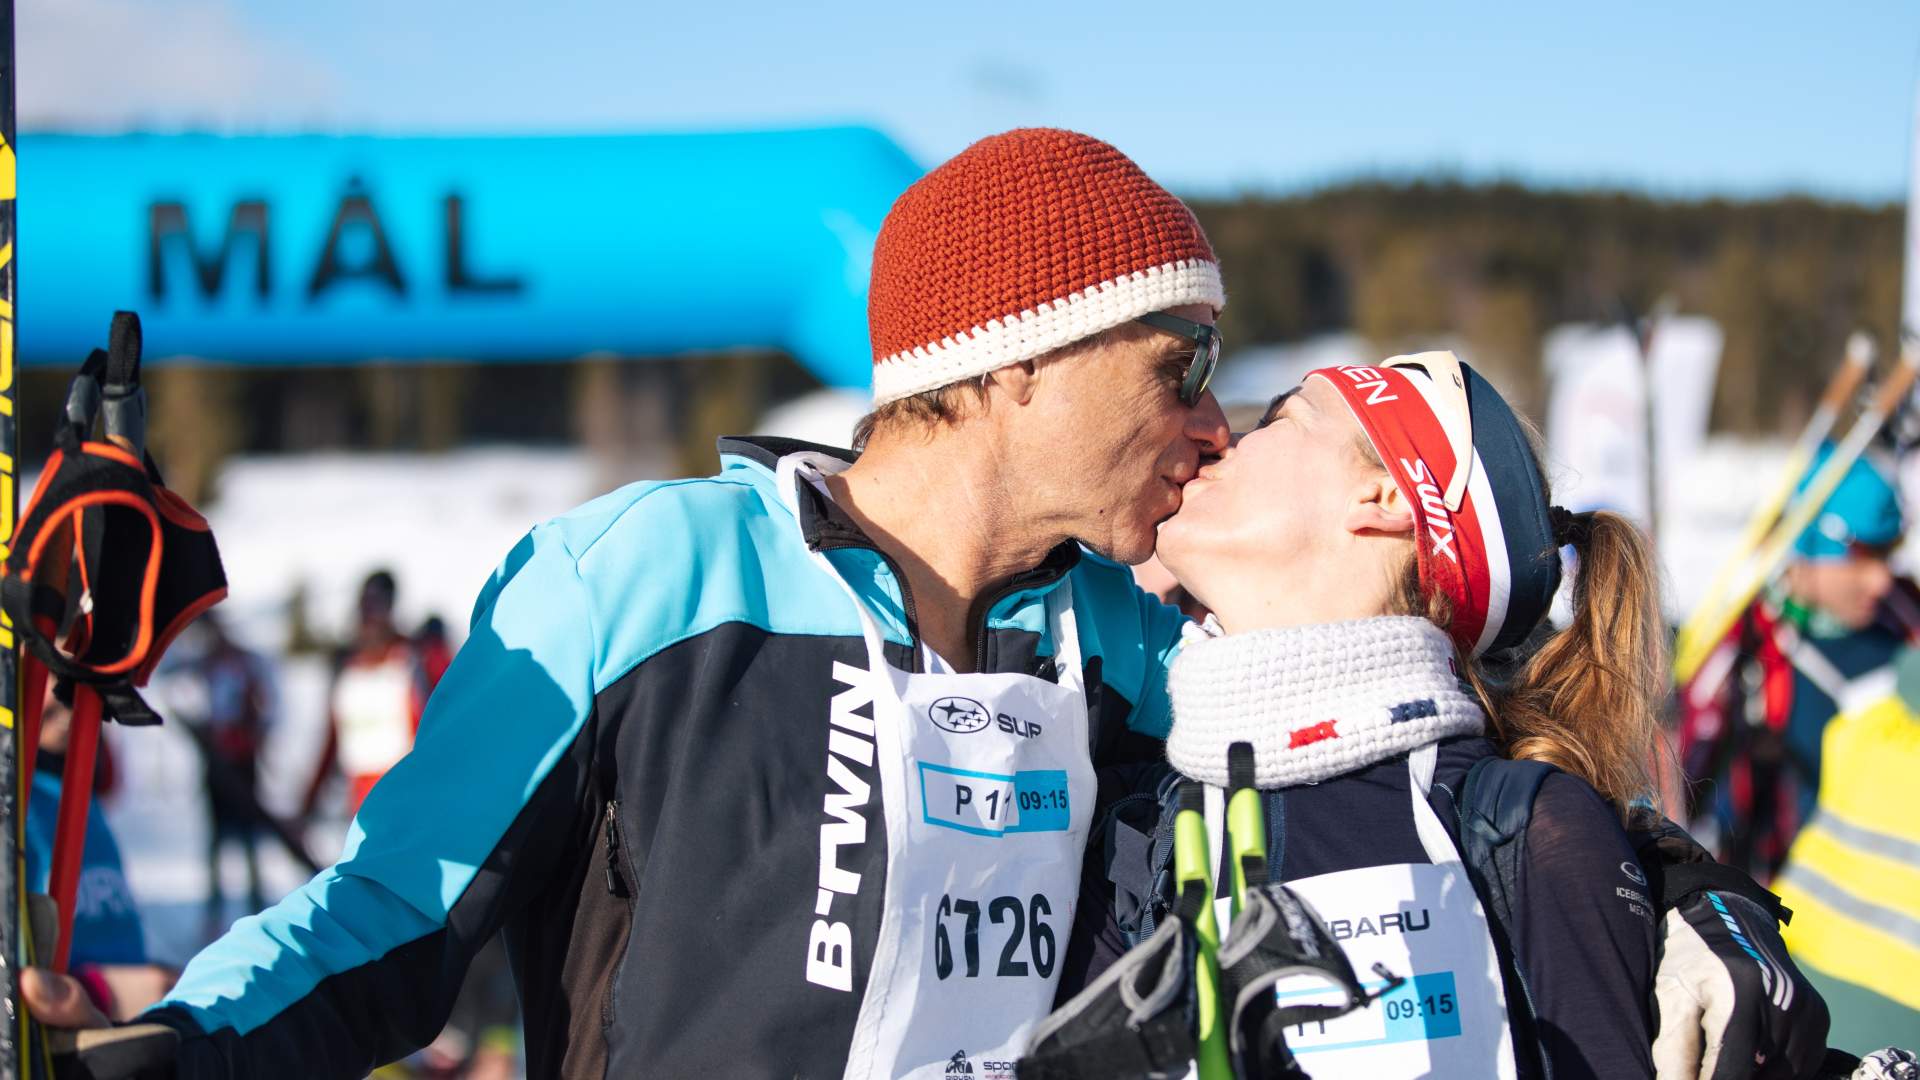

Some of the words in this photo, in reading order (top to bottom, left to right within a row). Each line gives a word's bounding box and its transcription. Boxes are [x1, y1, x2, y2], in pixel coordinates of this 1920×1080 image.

[149, 176, 525, 303] MÅL
[956, 784, 973, 816] P
[1020, 789, 1067, 811] 09:15
[935, 893, 1056, 981] 6726
[1325, 908, 1431, 941] BARU
[1386, 993, 1454, 1021] 09:15
